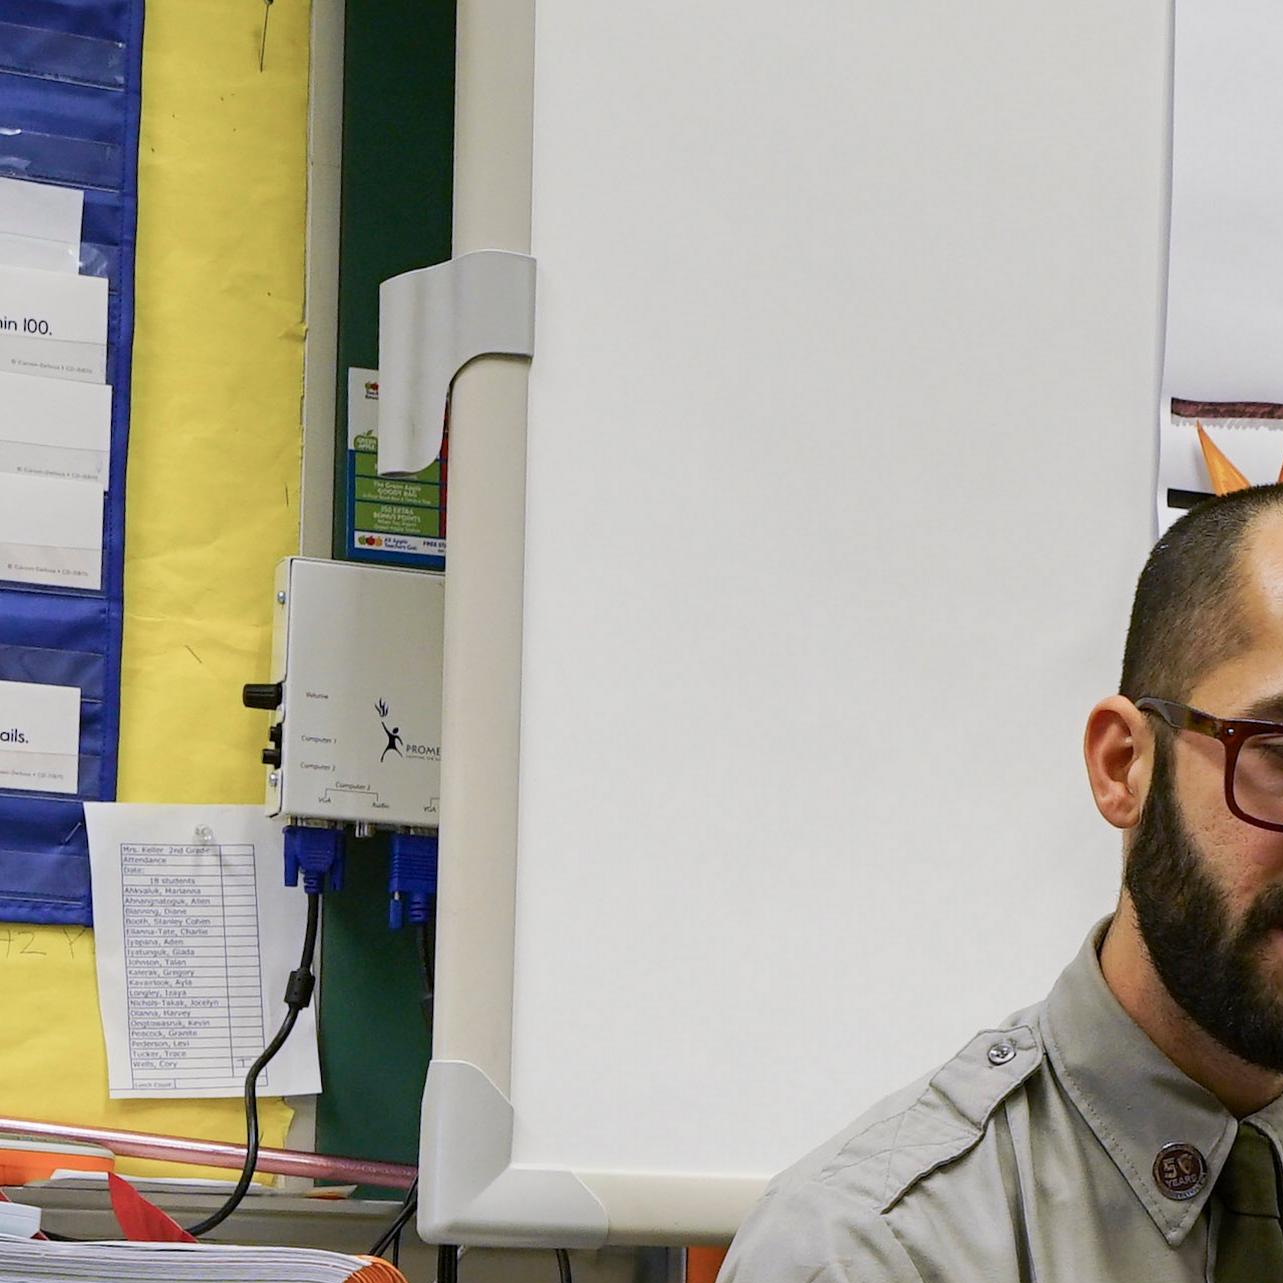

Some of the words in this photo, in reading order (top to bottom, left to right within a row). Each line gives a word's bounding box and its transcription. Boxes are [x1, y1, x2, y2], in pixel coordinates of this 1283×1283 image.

[24, 317, 52, 336] 100.
[301, 736, 332, 744] Computer
[336, 782, 366, 790] Computer
[1165, 1174, 1198, 1187] YEARS
